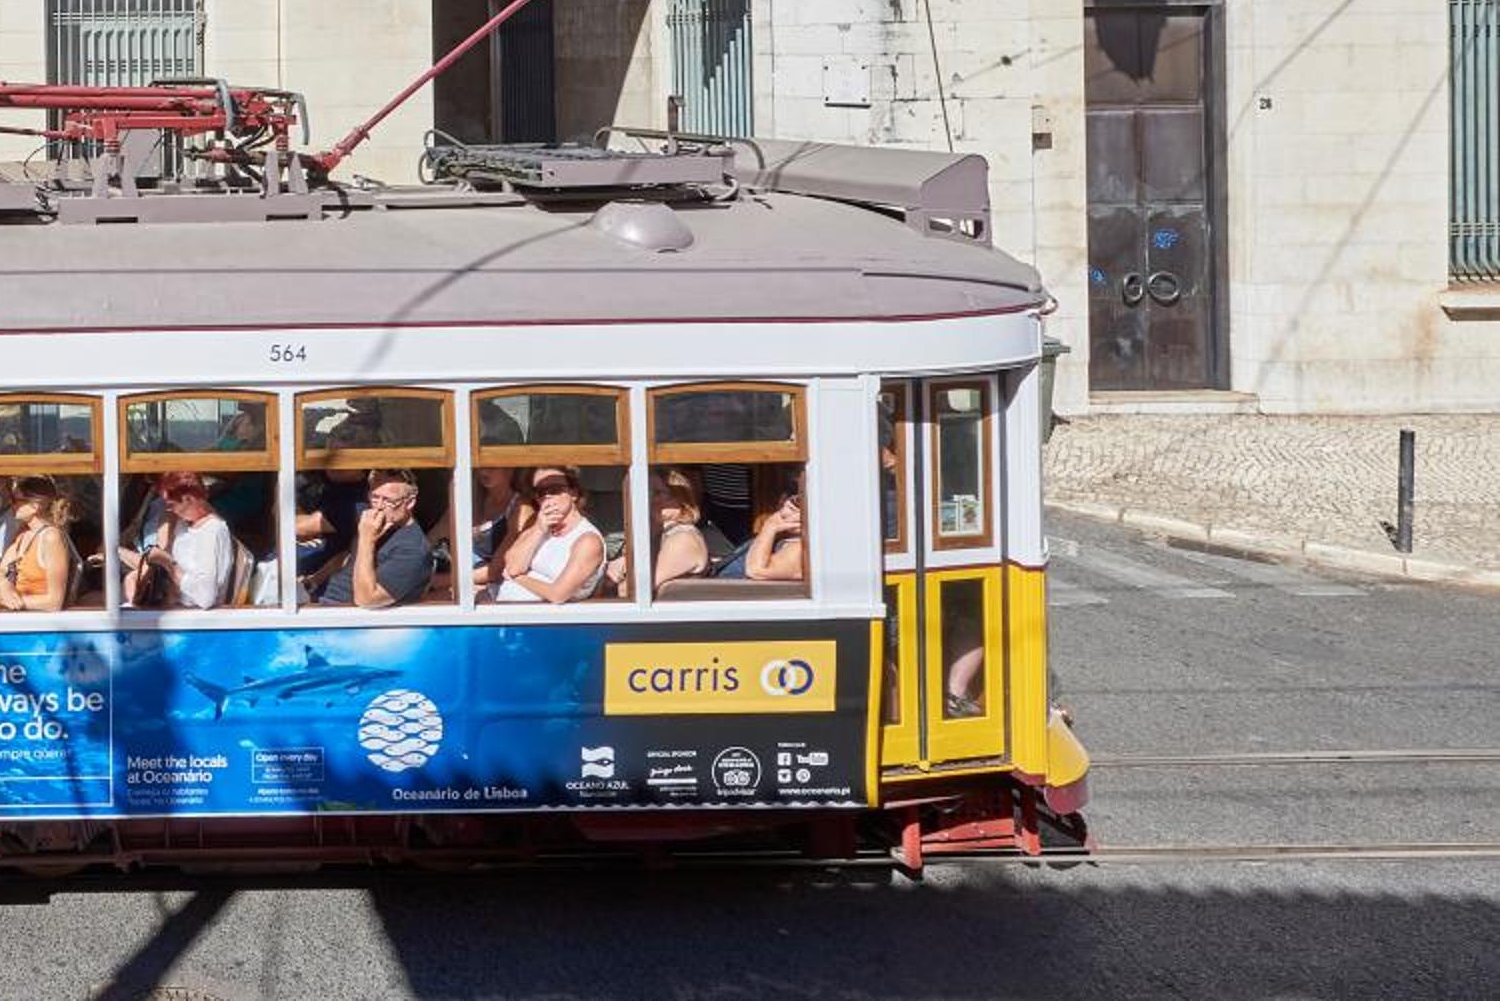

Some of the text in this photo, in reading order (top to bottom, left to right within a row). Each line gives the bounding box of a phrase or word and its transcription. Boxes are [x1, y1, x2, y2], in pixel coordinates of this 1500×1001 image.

[269, 344, 307, 362] 564
[627, 657, 740, 694] carris
[66, 686, 104, 712] be
[22, 715, 69, 741] do.
[127, 753, 228, 770] Meet the locals
[127, 768, 213, 784] at Oceanário
[392, 785, 529, 800] Oceanário de Lisboa
